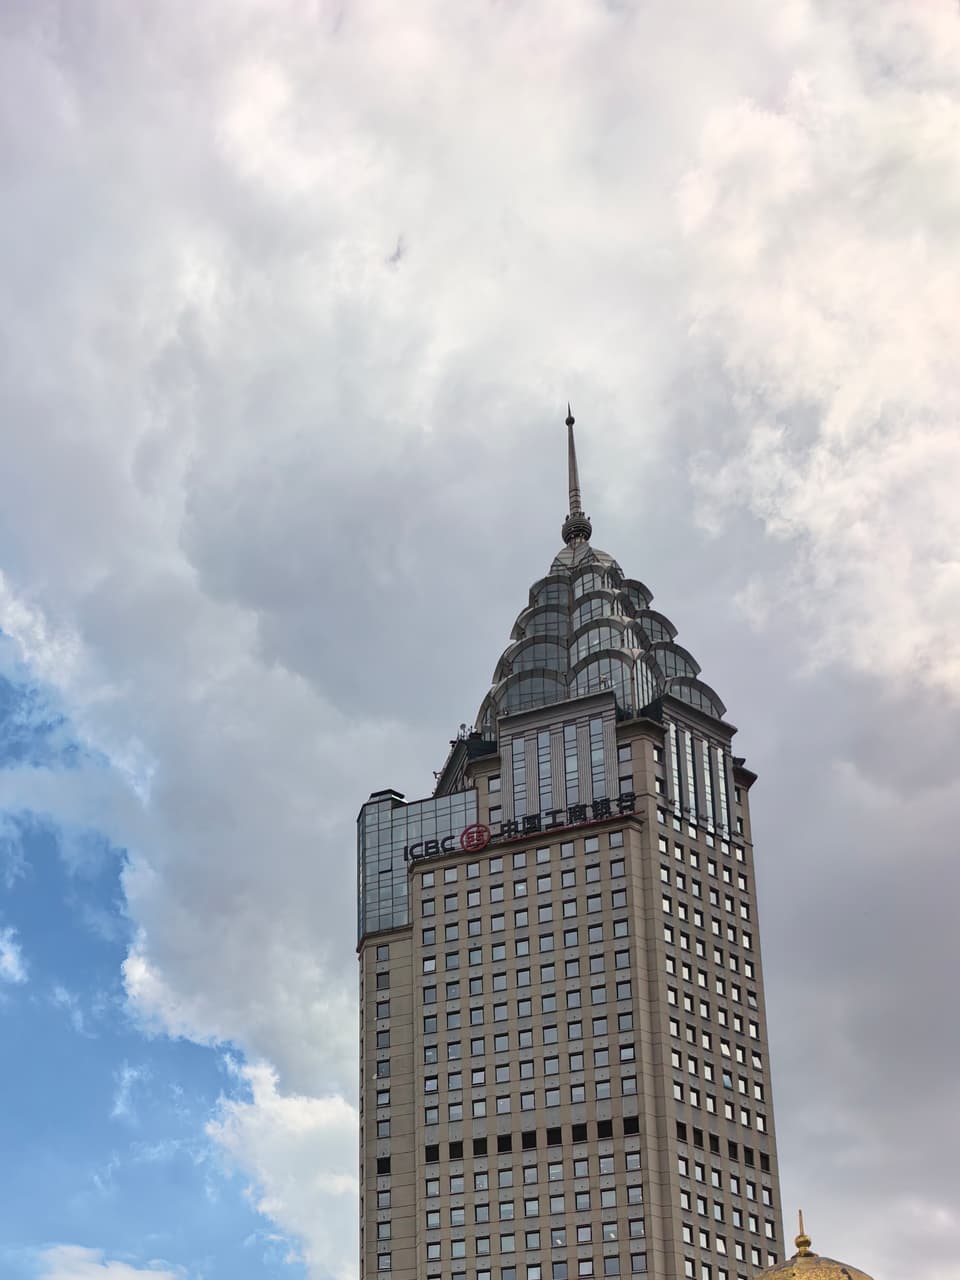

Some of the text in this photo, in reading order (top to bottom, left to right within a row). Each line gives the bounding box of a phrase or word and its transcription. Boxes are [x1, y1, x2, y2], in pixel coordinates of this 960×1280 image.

[501, 792, 636, 839] 中国工商银行
[404, 835, 455, 861] ICBC
